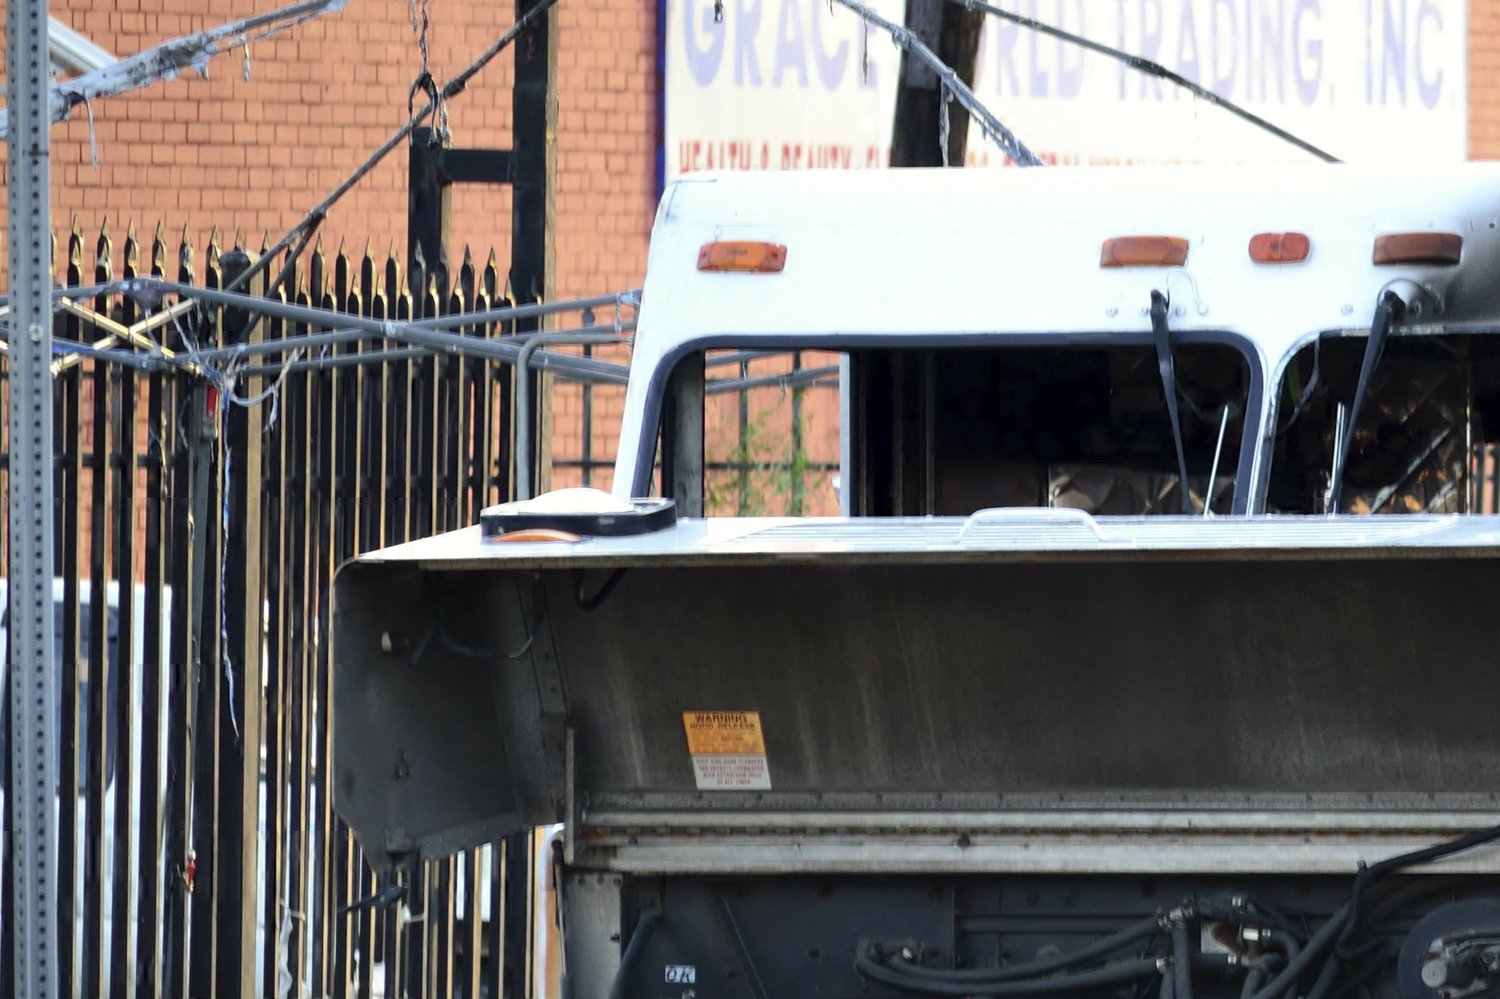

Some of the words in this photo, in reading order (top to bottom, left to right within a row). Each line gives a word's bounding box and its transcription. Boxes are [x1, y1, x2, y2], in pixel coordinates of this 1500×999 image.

[683, 0, 879, 91] GRACE
[695, 711, 748, 723] WARNING
[666, 965, 694, 984] OK
